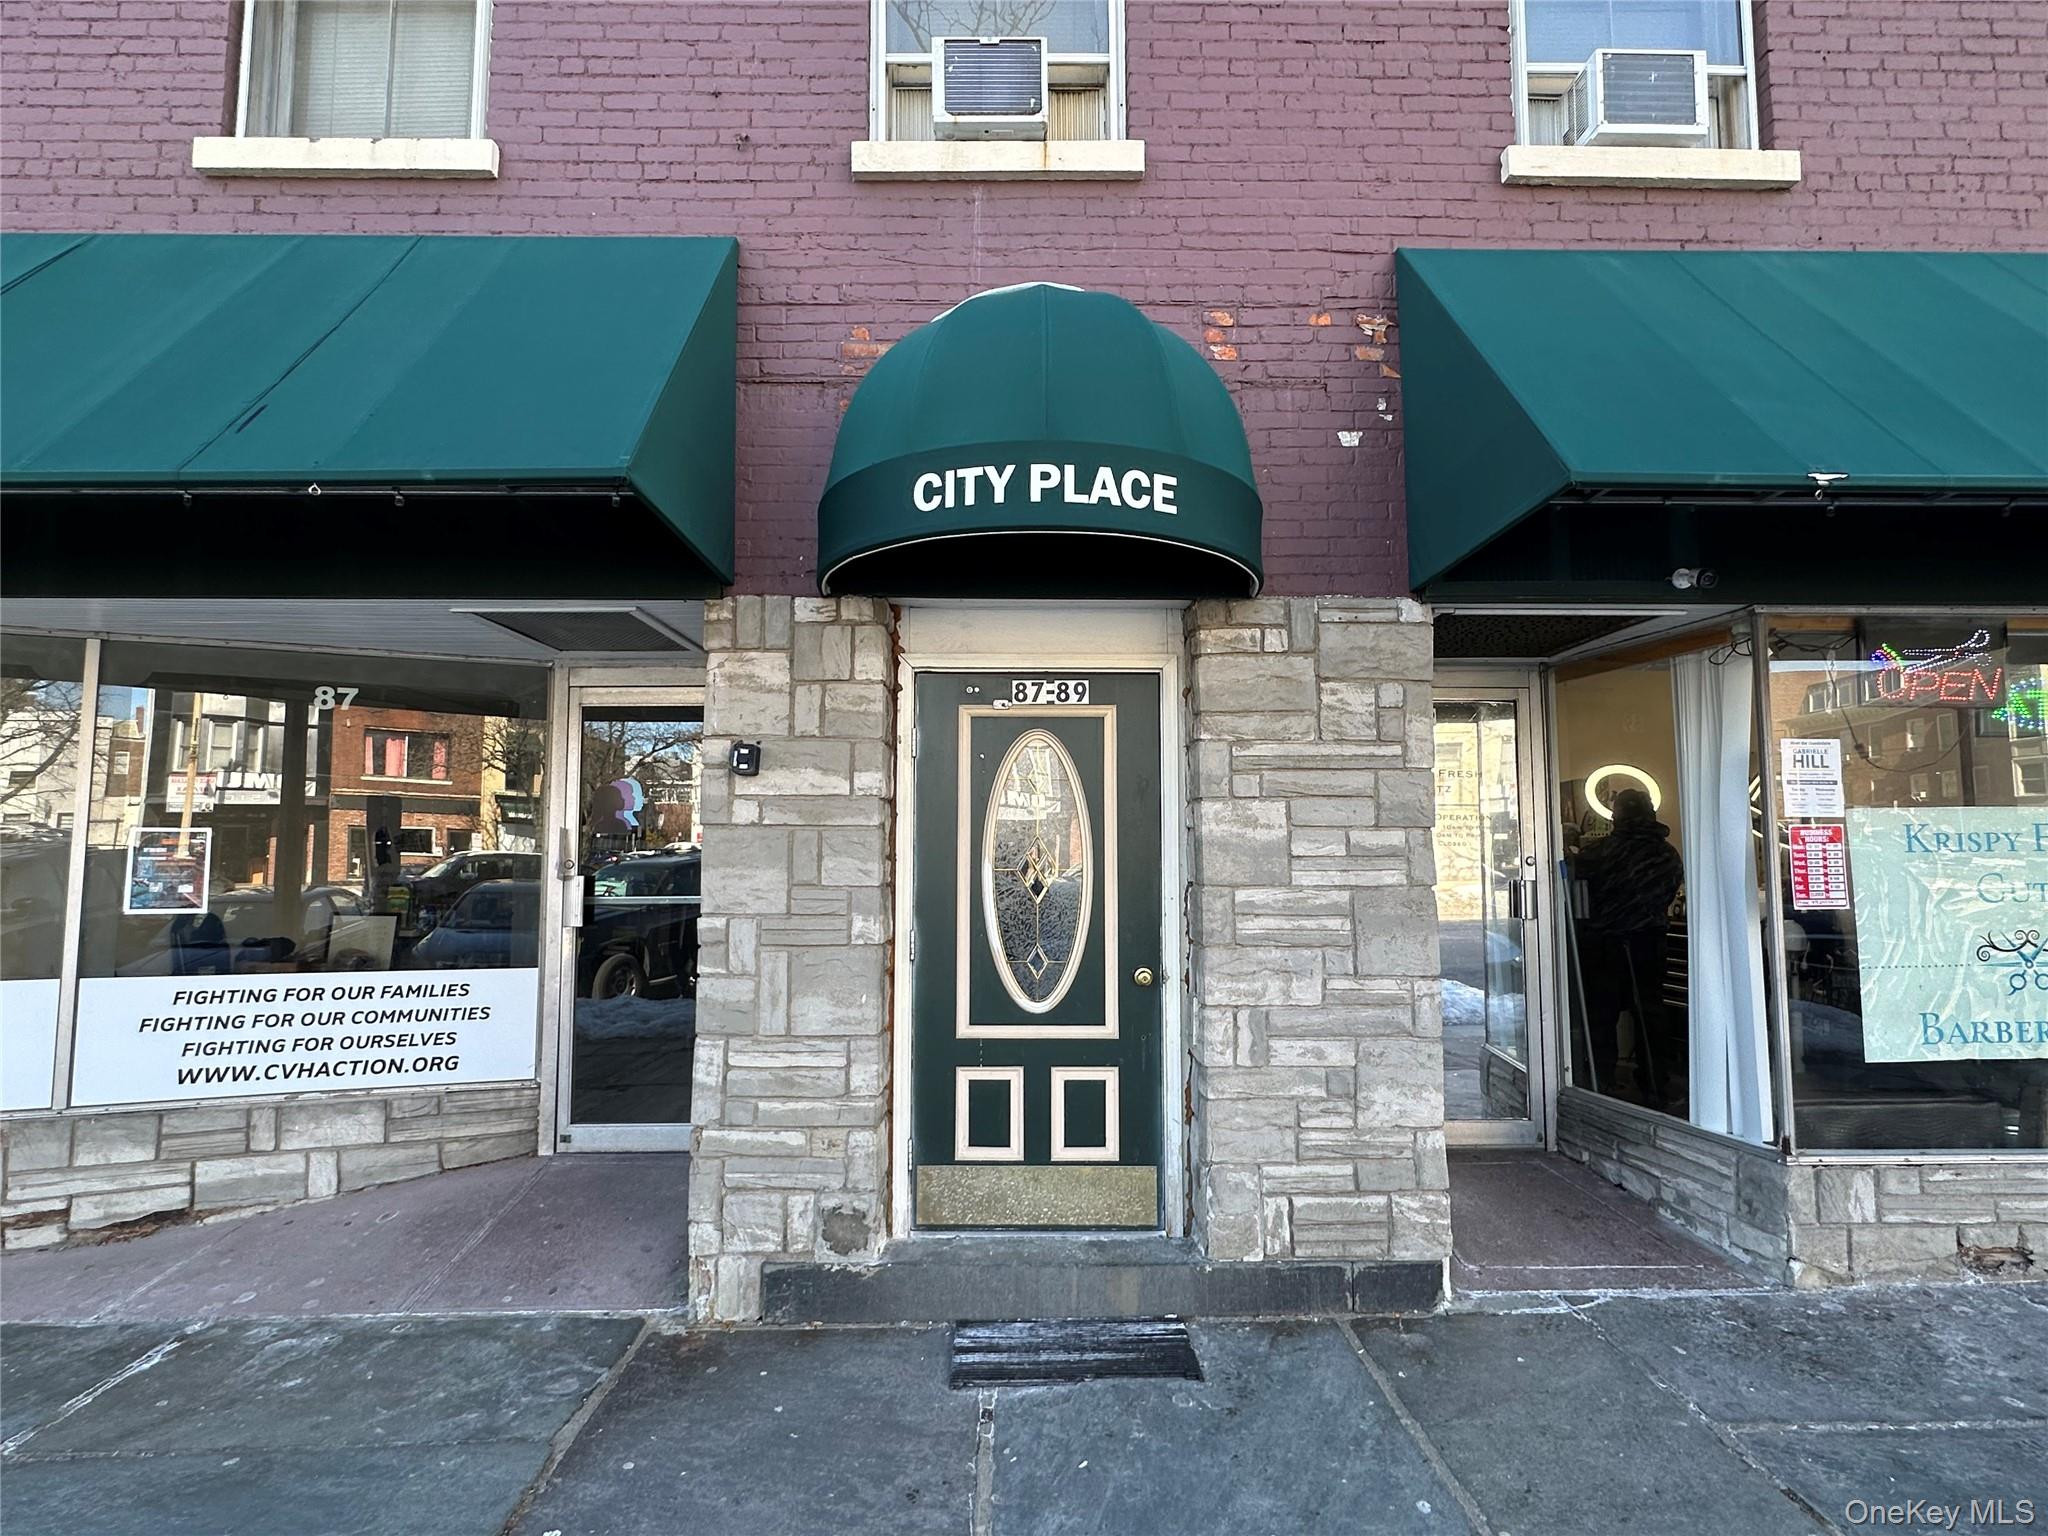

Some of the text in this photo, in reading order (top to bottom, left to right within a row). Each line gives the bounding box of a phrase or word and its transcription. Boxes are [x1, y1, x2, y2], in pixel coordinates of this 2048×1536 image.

[912, 463, 1178, 515] CITY PLACE
[1013, 681, 1088, 703] 87-89
[1876, 664, 2003, 701] OPEN
[313, 685, 360, 711] 87
[1438, 769, 1482, 779] FRESH
[1793, 754, 1830, 769] HILL
[1902, 822, 2023, 853] KRISPY
[172, 983, 471, 1006] FIGHTING FOR OUR FAMILIES
[138, 1006, 491, 1033] FIGHTING FOR OUR COMMUNITIES
[181, 1031, 458, 1057] FIGHTING FOR OURSELVES
[177, 1055, 460, 1085] WWW.CVHACTION.ORG
